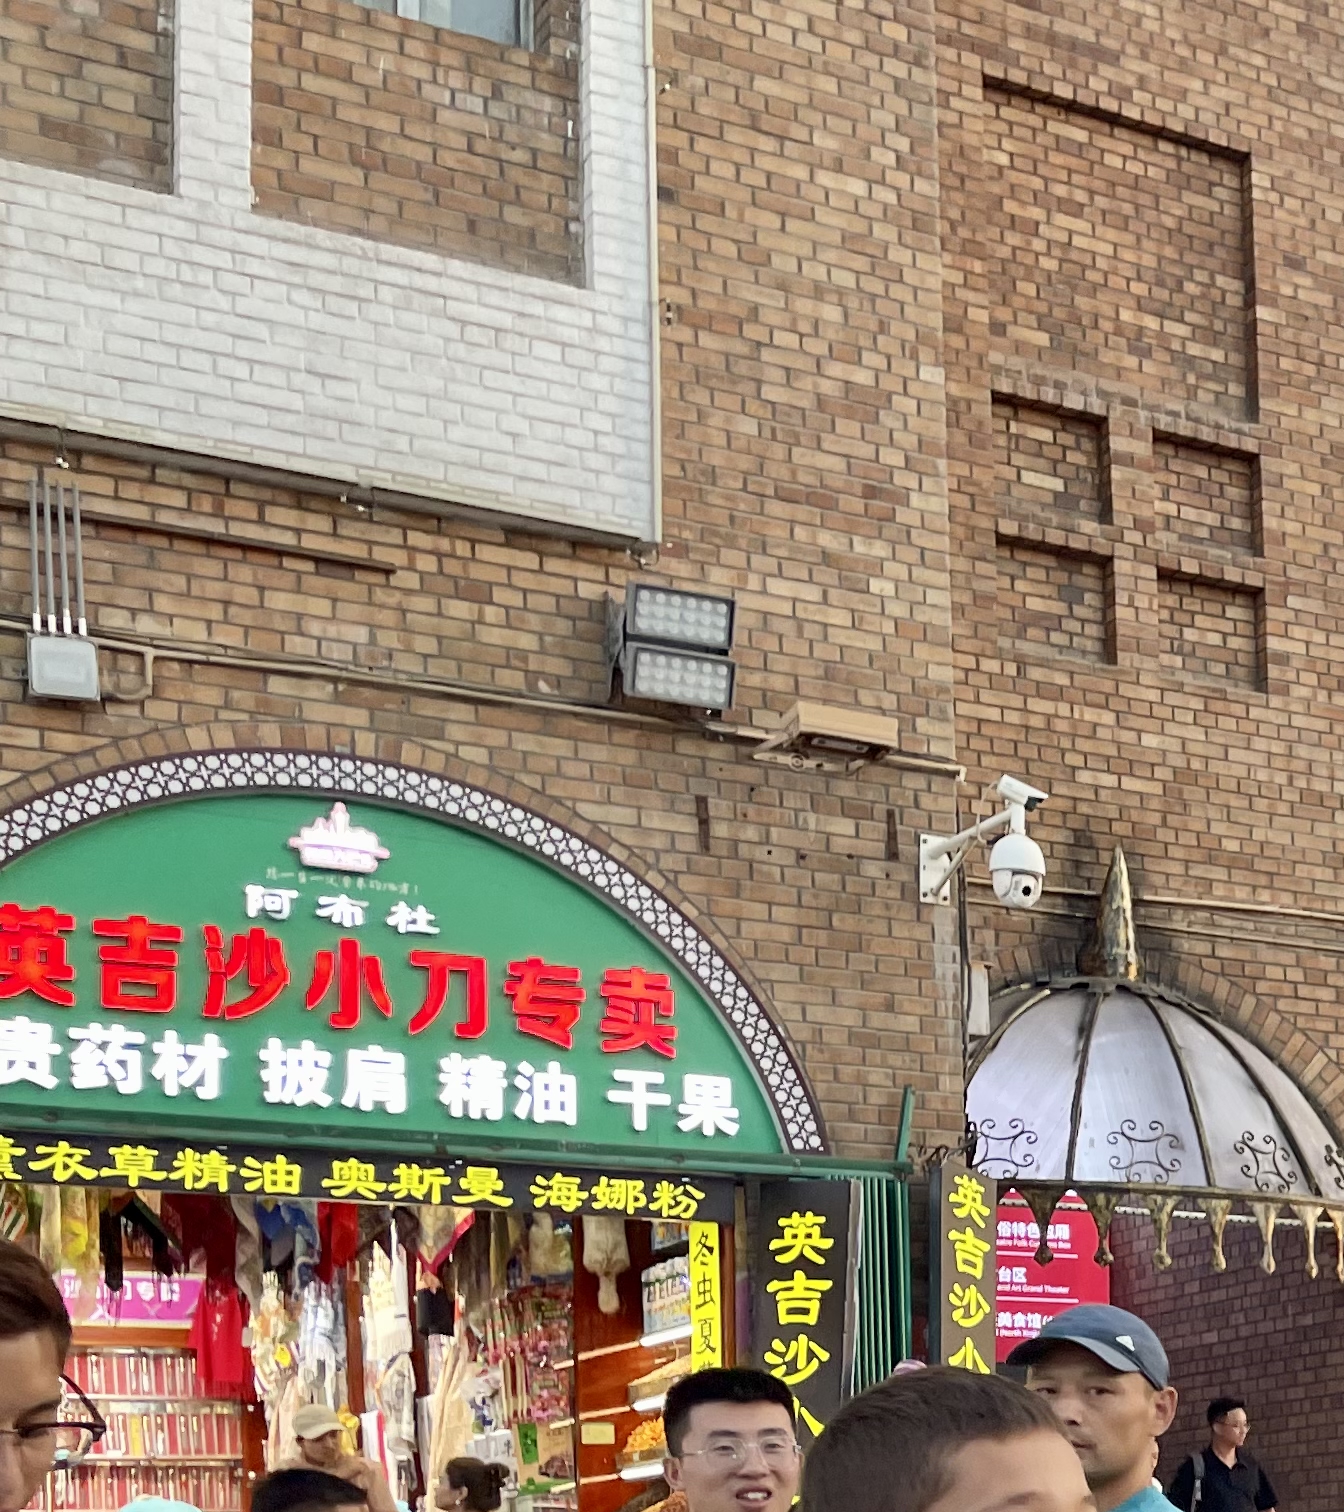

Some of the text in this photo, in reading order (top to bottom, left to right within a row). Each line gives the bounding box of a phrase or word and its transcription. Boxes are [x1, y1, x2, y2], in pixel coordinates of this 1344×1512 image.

[0, 902, 680, 1060] 英吉沙小刀专卖
[0, 1015, 742, 1138] 贵药材 披肩 精油 干果
[321, 1157, 515, 1209] 奥斯曼
[530, 1172, 706, 1220] 海娜粉
